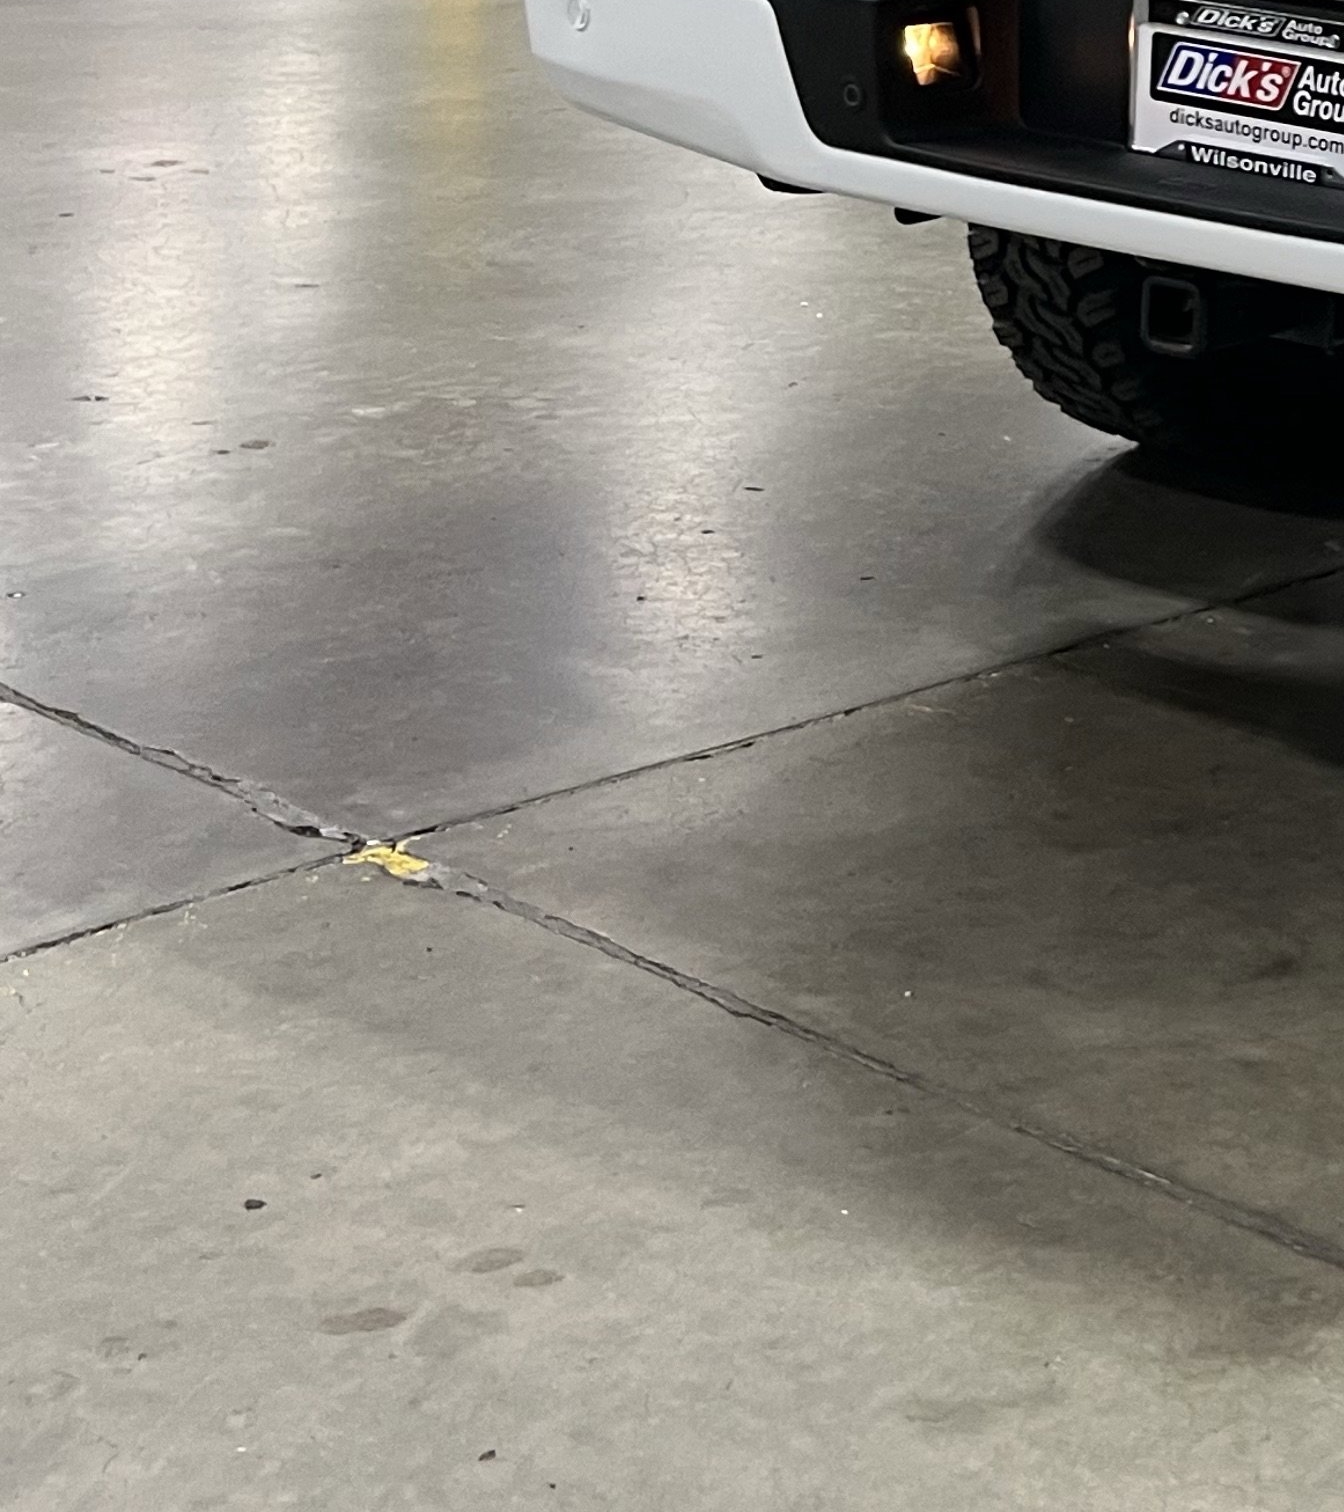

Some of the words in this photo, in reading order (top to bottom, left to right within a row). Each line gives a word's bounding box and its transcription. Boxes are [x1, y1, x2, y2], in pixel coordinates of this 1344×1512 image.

[1197, 8, 1275, 34] Dick's
[1284, 19, 1324, 35] Auto
[1167, 49, 1284, 103] Dick's
[1169, 107, 1344, 155] dicksautogroup.com
[1190, 144, 1317, 184] Wilsonville
